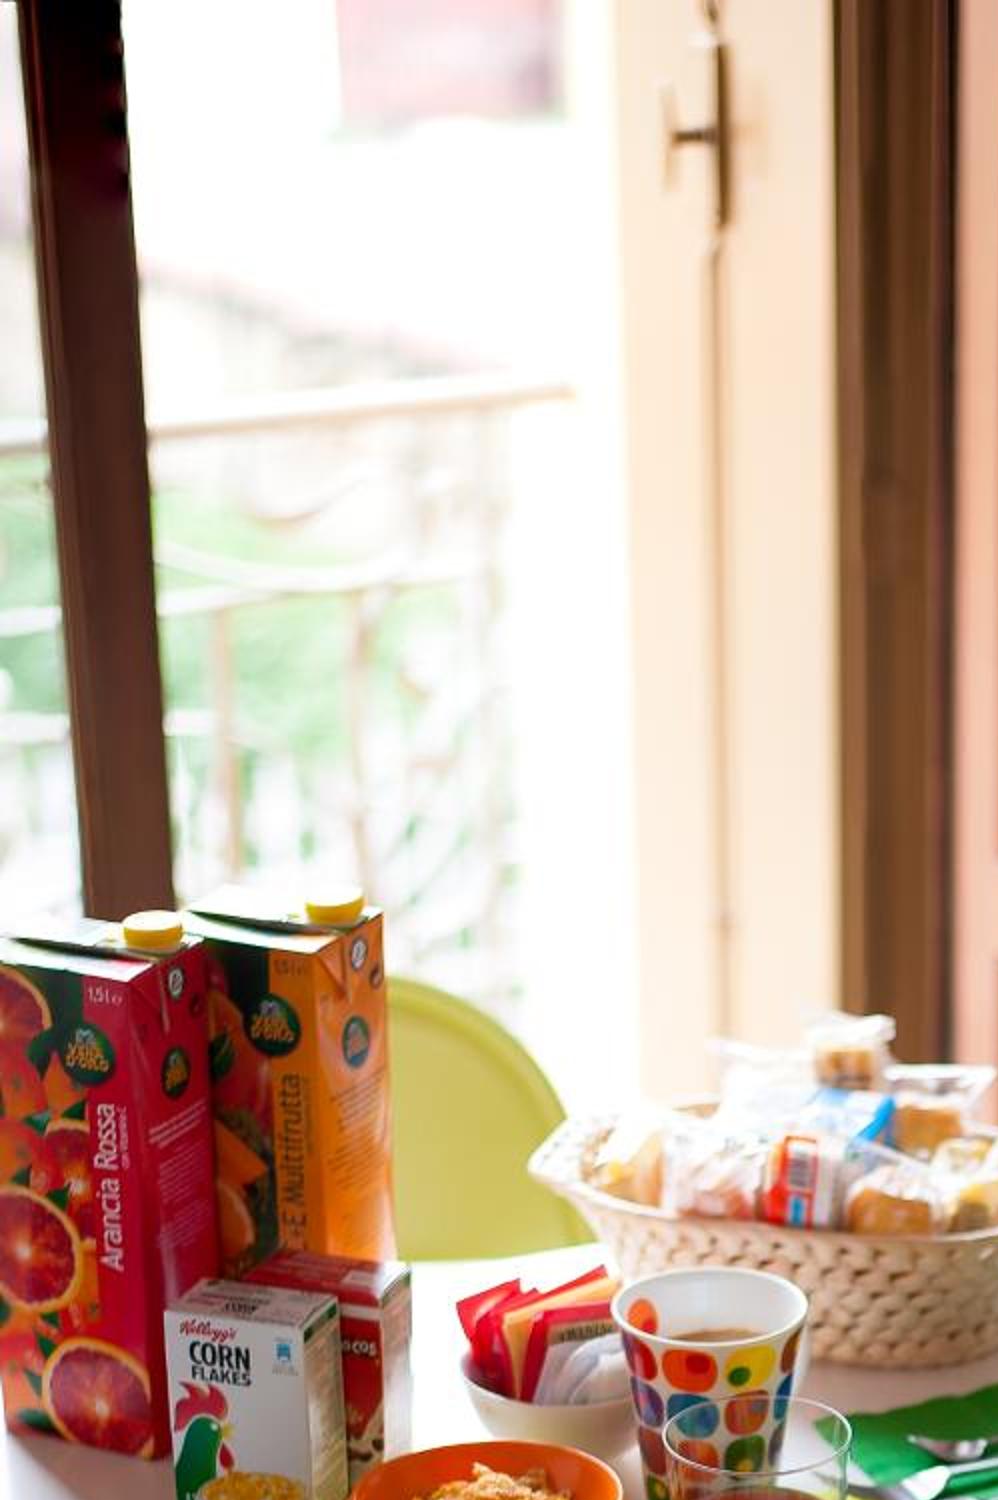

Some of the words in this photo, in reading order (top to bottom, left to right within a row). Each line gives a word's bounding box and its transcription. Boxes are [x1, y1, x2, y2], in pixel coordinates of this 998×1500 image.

[93, 1103, 121, 1171] Rossa
[279, 1073, 307, 1208] Multifrutta
[95, 1176, 126, 1273] Arancia
[179, 1318, 239, 1344] Kellogg's
[189, 1340, 251, 1371] CORN
[191, 1365, 252, 1387] FLAKES
